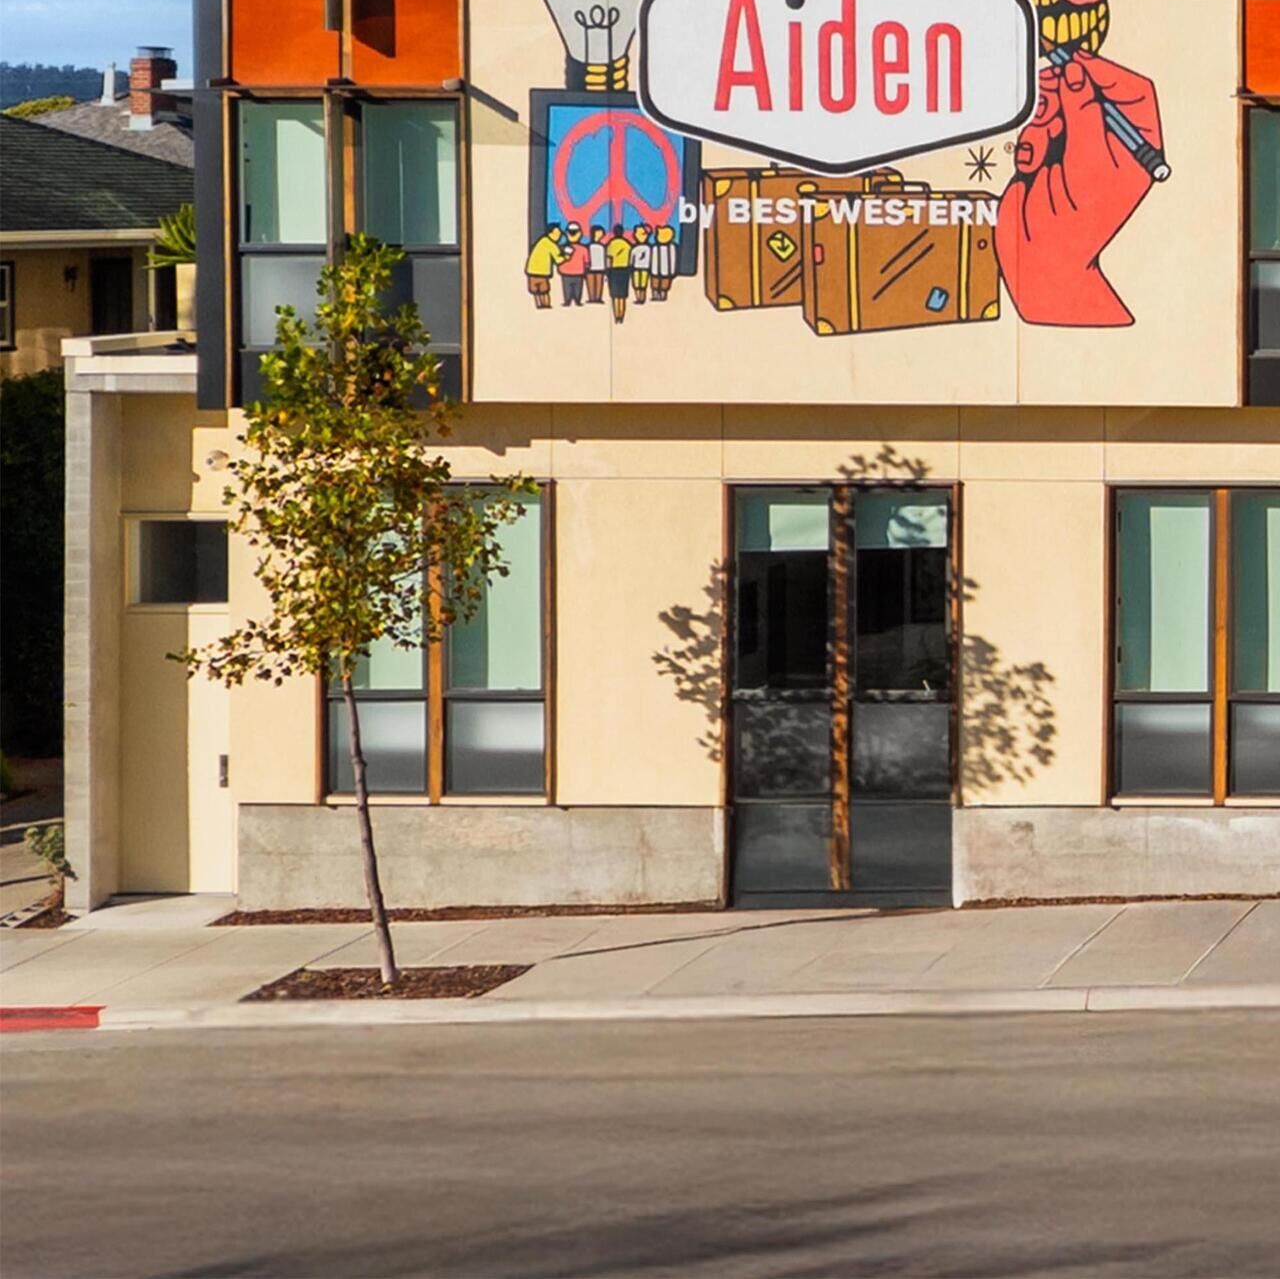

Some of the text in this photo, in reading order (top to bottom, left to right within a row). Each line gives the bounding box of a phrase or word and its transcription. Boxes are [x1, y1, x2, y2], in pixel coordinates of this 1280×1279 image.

[677, 195, 999, 229] by BEST WESTERN
